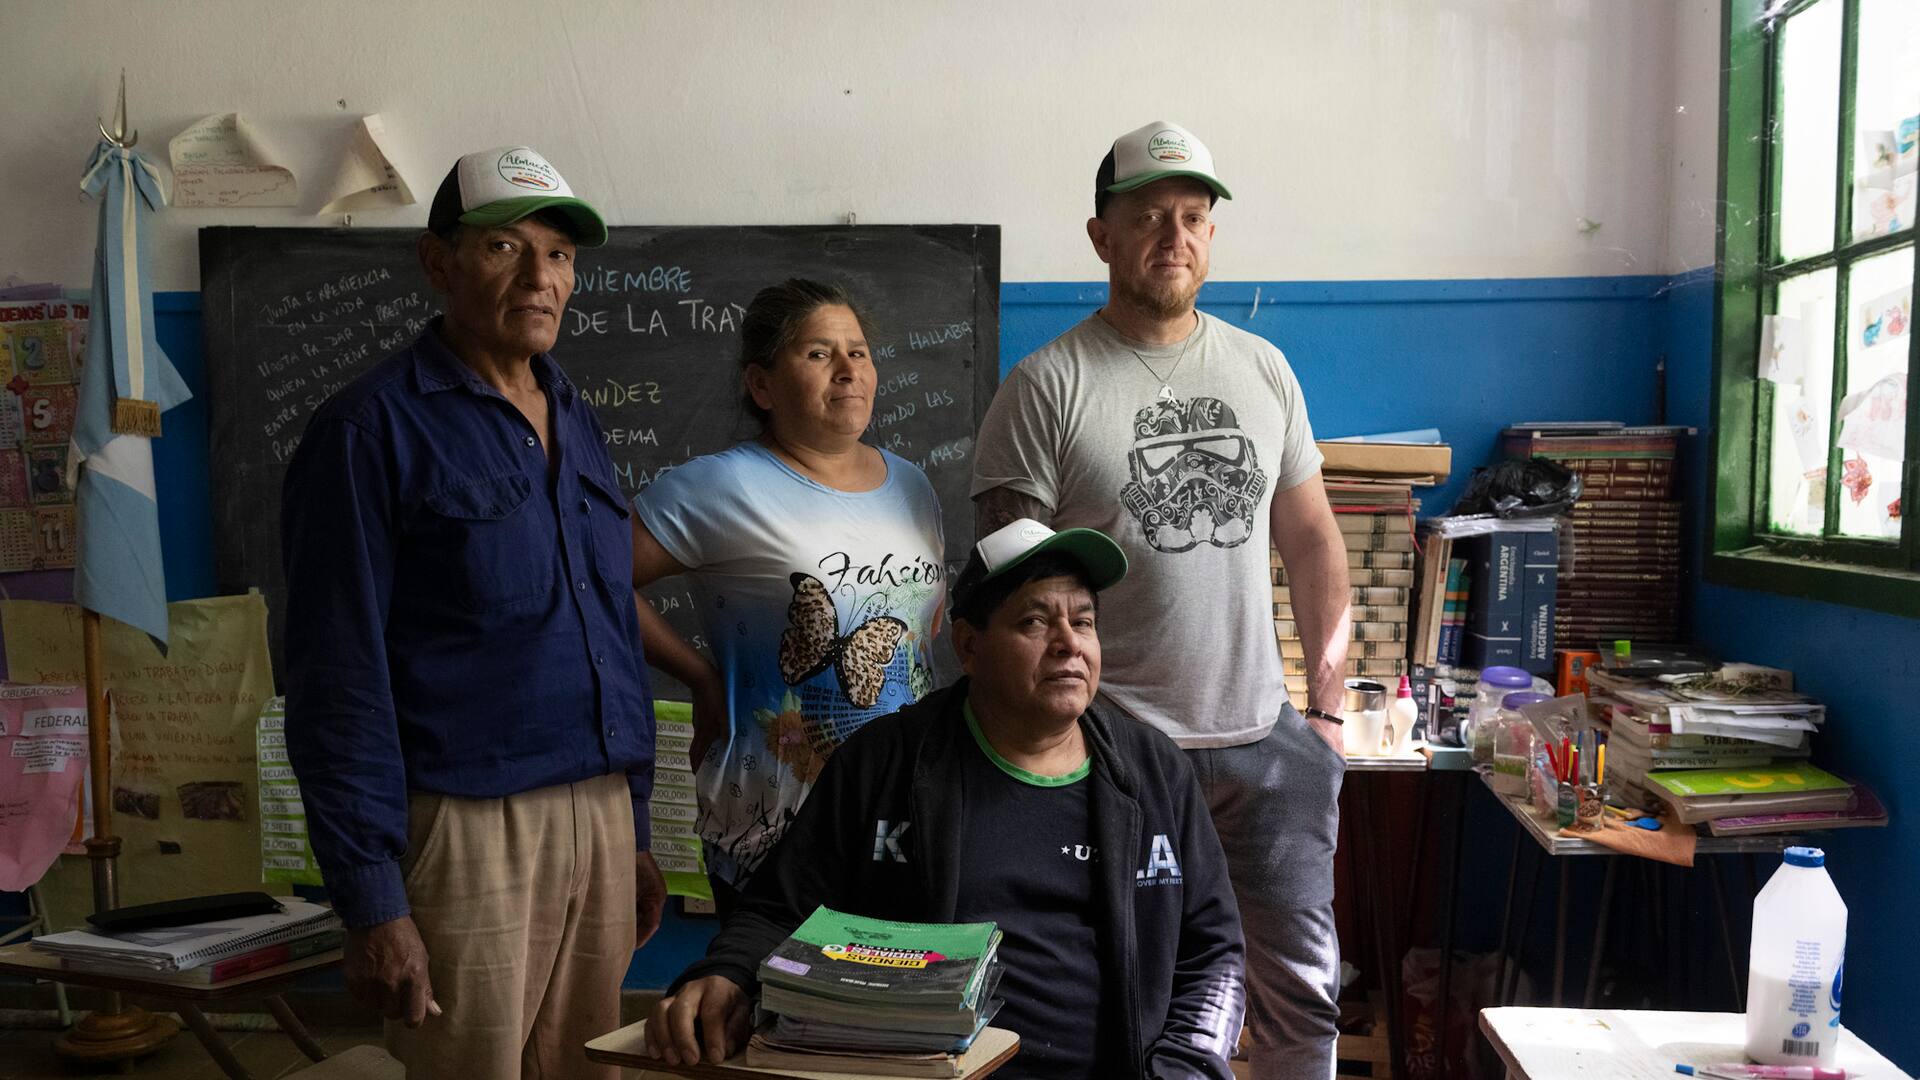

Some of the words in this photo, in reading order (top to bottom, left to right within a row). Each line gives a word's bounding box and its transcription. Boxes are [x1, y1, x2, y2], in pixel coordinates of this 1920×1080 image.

[333, 296, 366, 317] VIDA
[568, 307, 608, 336] DE
[627, 303, 668, 336] LA
[324, 327, 354, 347] DAR
[360, 320, 376, 337] Y
[311, 364, 329, 379] LA
[333, 344, 369, 369] TIENE
[925, 389, 954, 408] LAS
[1498, 545, 1509, 601] ARGENTINA
[1537, 604, 1548, 660] ARGENTINA
[34, 715, 88, 729] FEDERAL
[872, 818, 911, 863] K
[1136, 834, 1182, 879] A
[847, 953, 920, 967] CIENCIAS
[852, 946, 925, 960] SOCIALES
